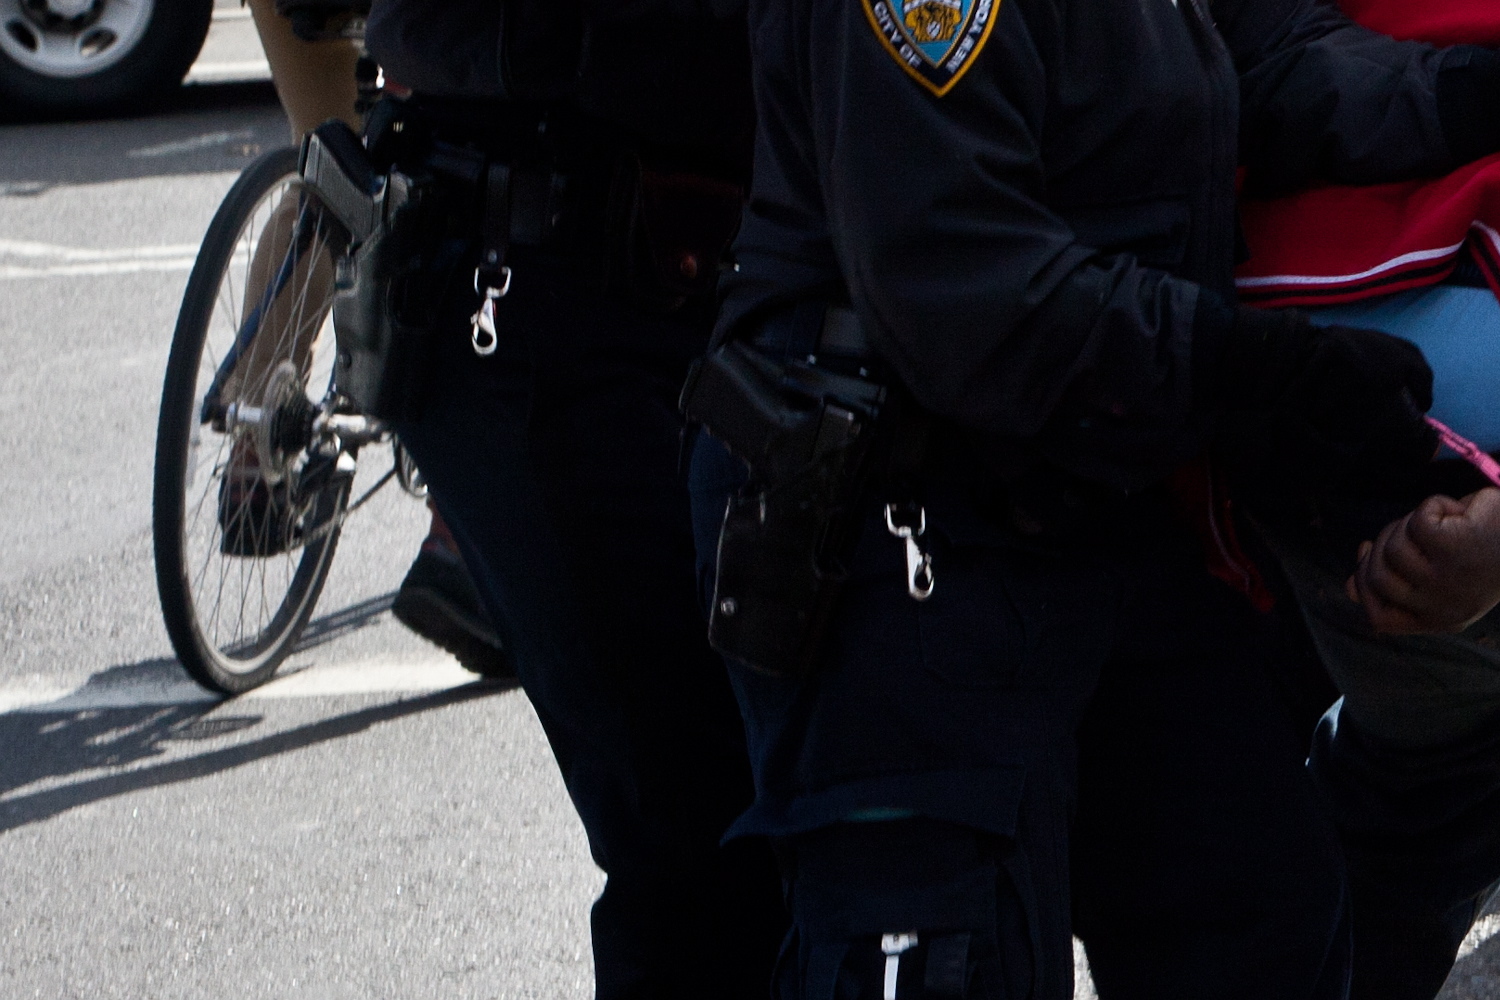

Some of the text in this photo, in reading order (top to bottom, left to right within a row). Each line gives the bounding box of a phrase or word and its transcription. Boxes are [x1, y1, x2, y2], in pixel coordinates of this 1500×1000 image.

[873, 1, 922, 68] CITY OF
[945, 34, 976, 73] NEW
